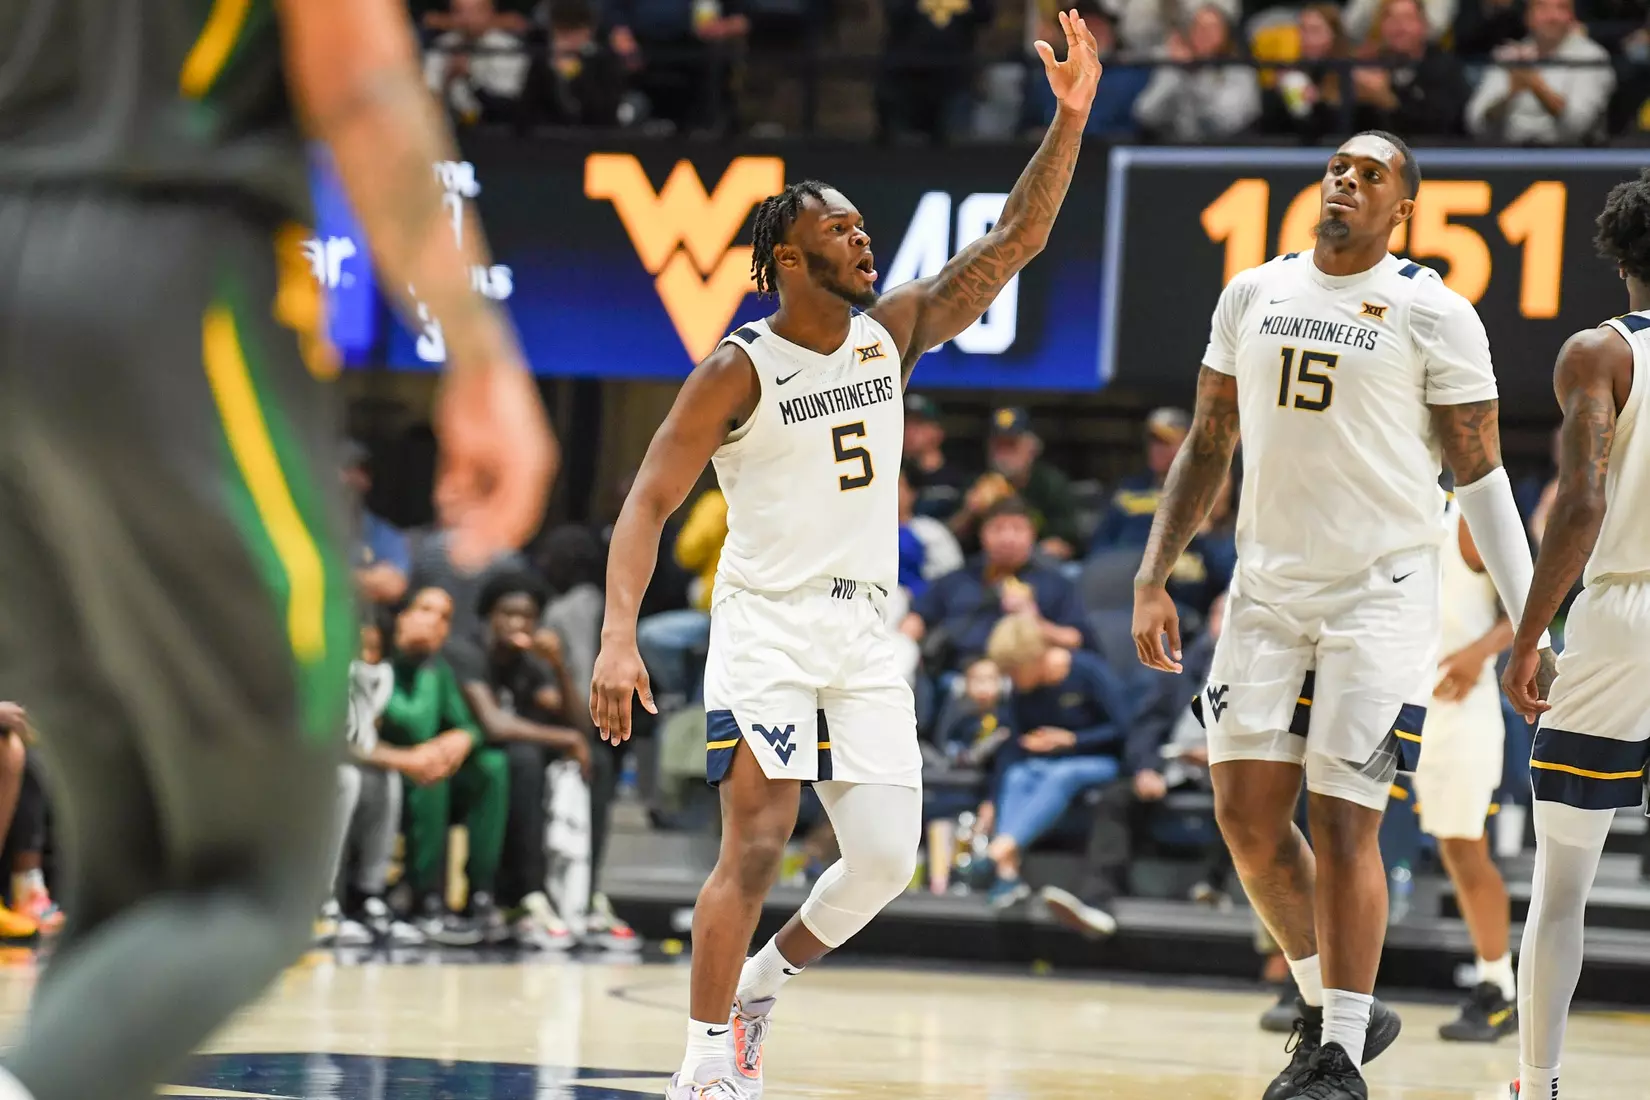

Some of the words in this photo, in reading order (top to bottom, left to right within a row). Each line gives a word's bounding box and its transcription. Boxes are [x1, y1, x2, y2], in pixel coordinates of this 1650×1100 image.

[1359, 301, 1388, 322] XII
[1260, 315, 1378, 351] MOUNTAINEERS
[855, 341, 886, 365] XII
[1278, 347, 1340, 412] 15
[779, 376, 893, 425] MOUNTAINEERS
[831, 420, 874, 492] 5
[831, 577, 857, 600] WVU
